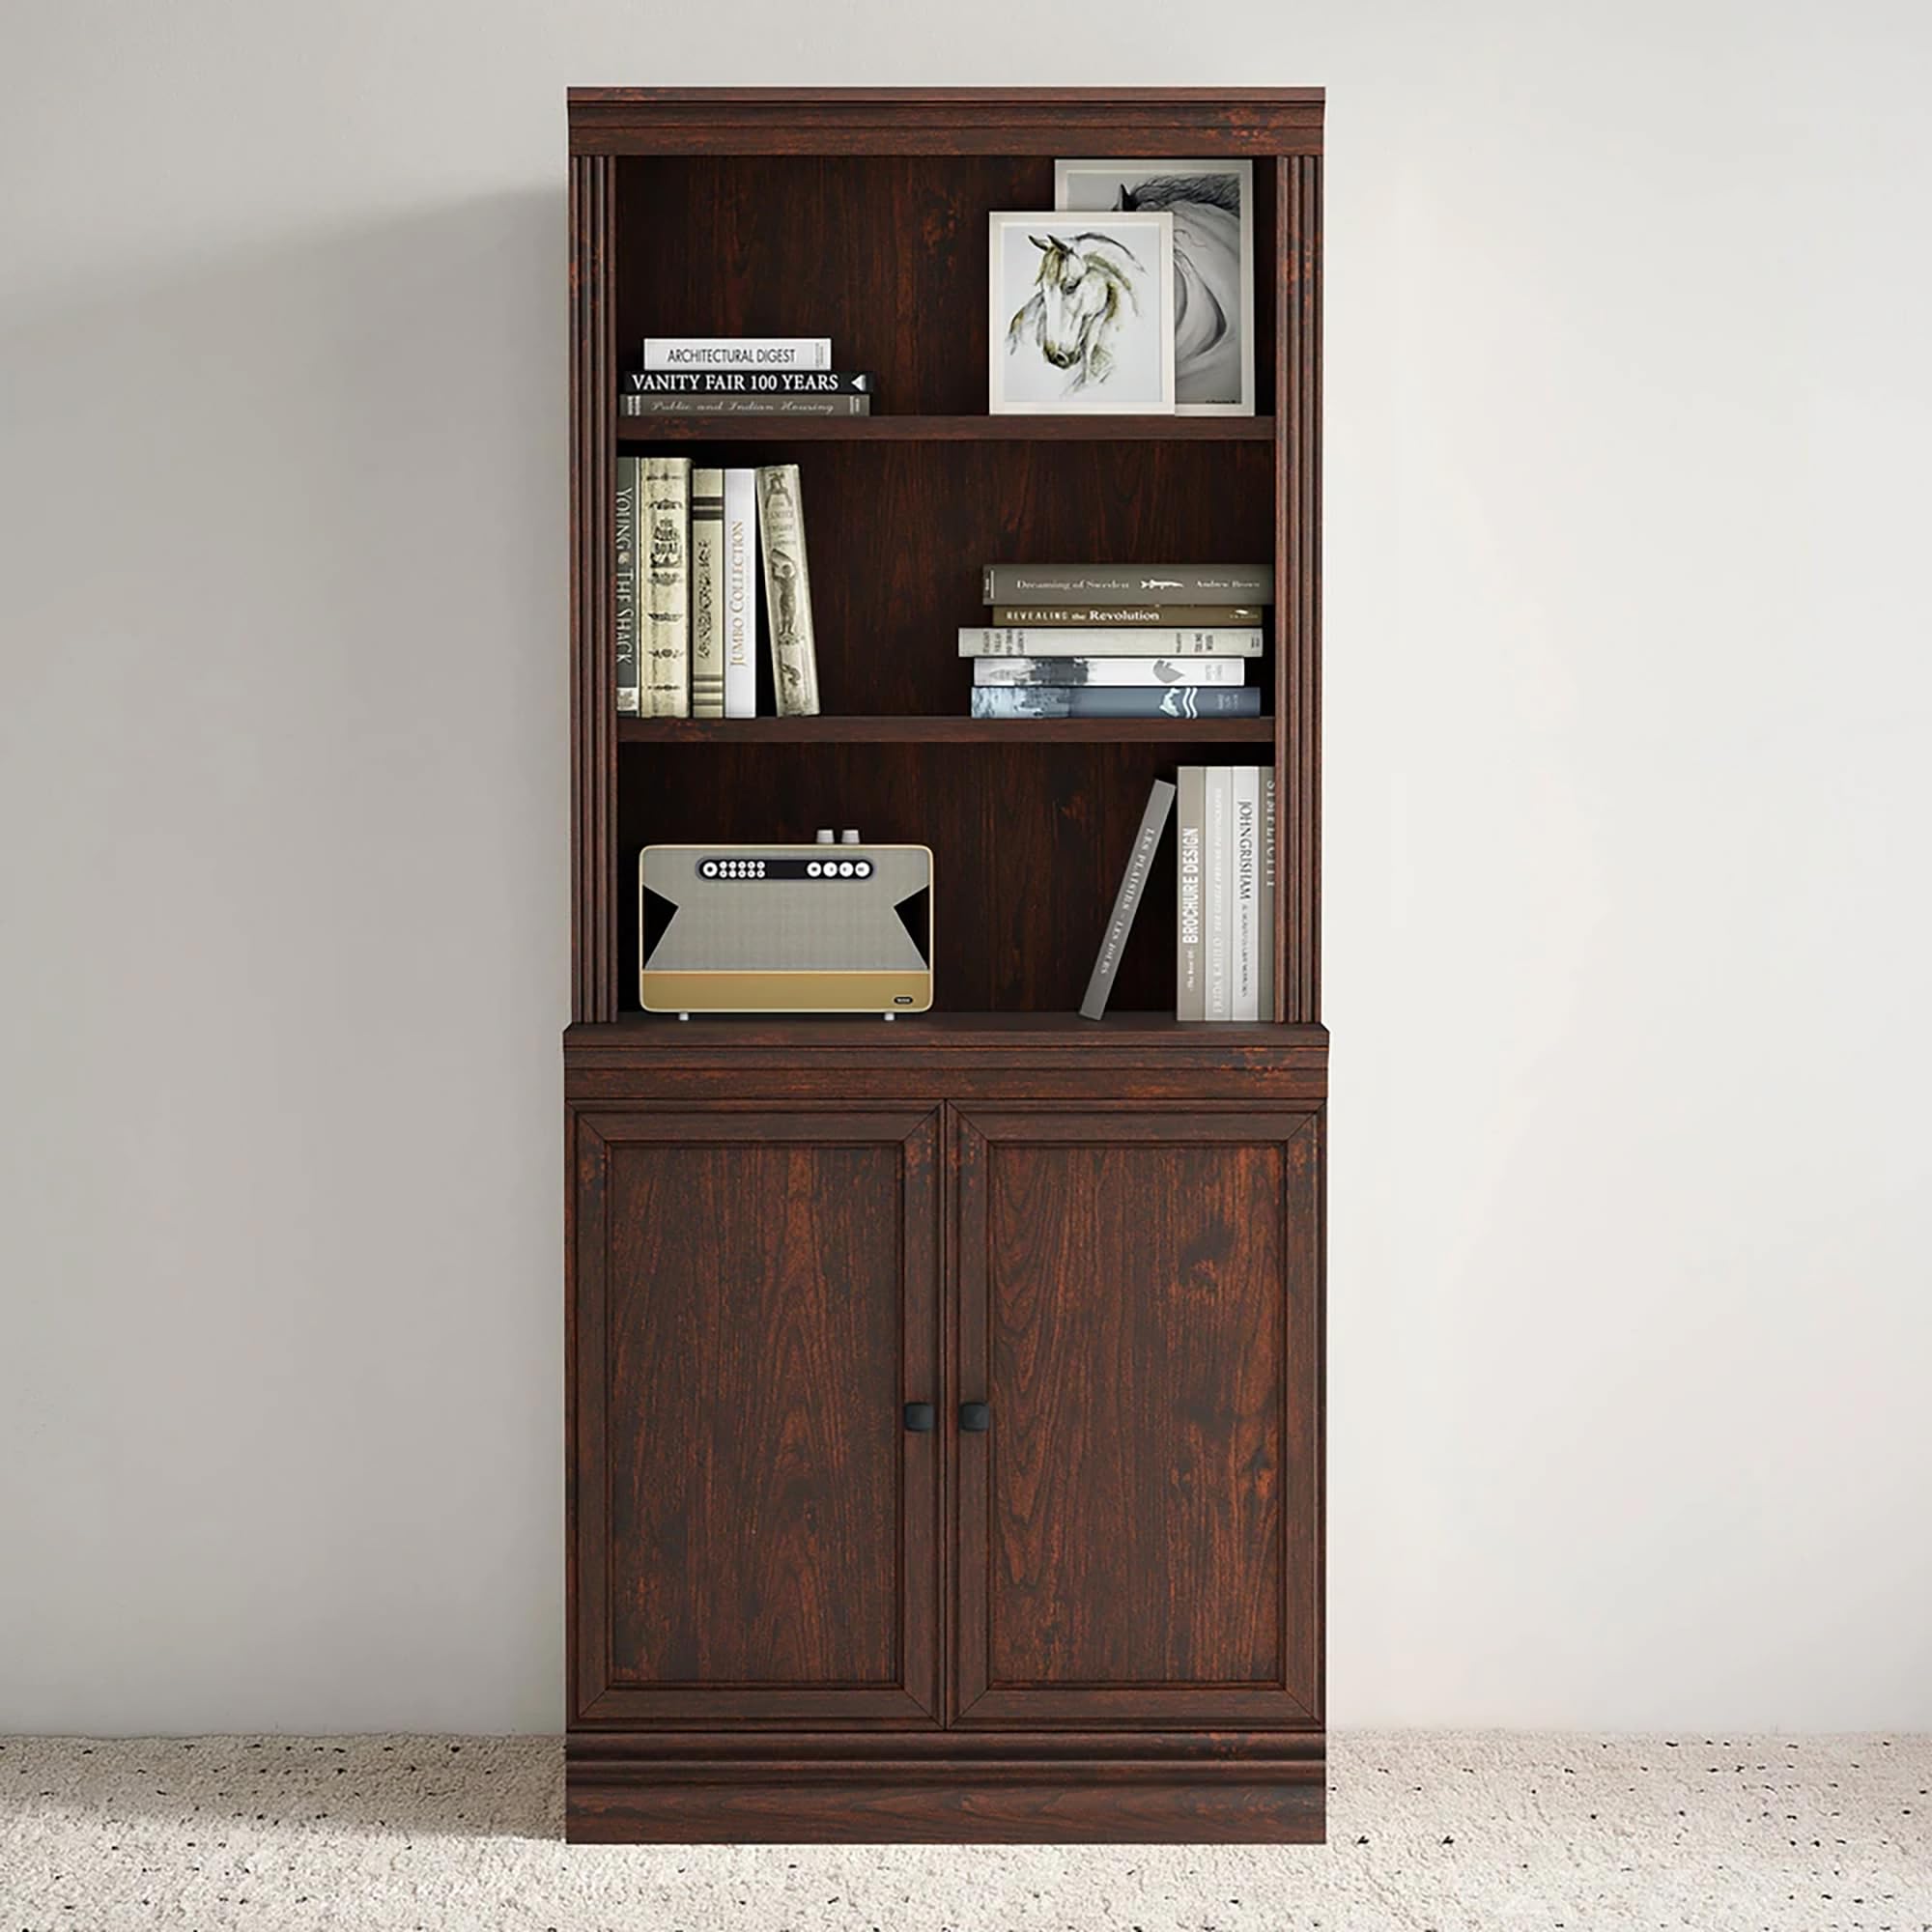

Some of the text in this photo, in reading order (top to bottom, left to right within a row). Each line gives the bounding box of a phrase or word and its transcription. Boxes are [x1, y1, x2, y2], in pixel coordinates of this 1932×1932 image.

[668, 348, 795, 363] ARCHITECTURAL DIGEST
[631, 374, 838, 391] VANITY FAIR 100 YEARS
[651, 401, 835, 415] Public and Indian Housing
[616, 488, 633, 549] YOUNG
[729, 521, 746, 667] JUMBO COLLECTION
[1016, 580, 1070, 591] Dreaming
[1072, 580, 1086, 588] of
[1007, 610, 1160, 621] REVEALING the Revolution
[616, 609, 634, 665] SHACK
[1142, 827, 1155, 851] LES
[1181, 827, 1199, 944] BROCHURE DESIGN
